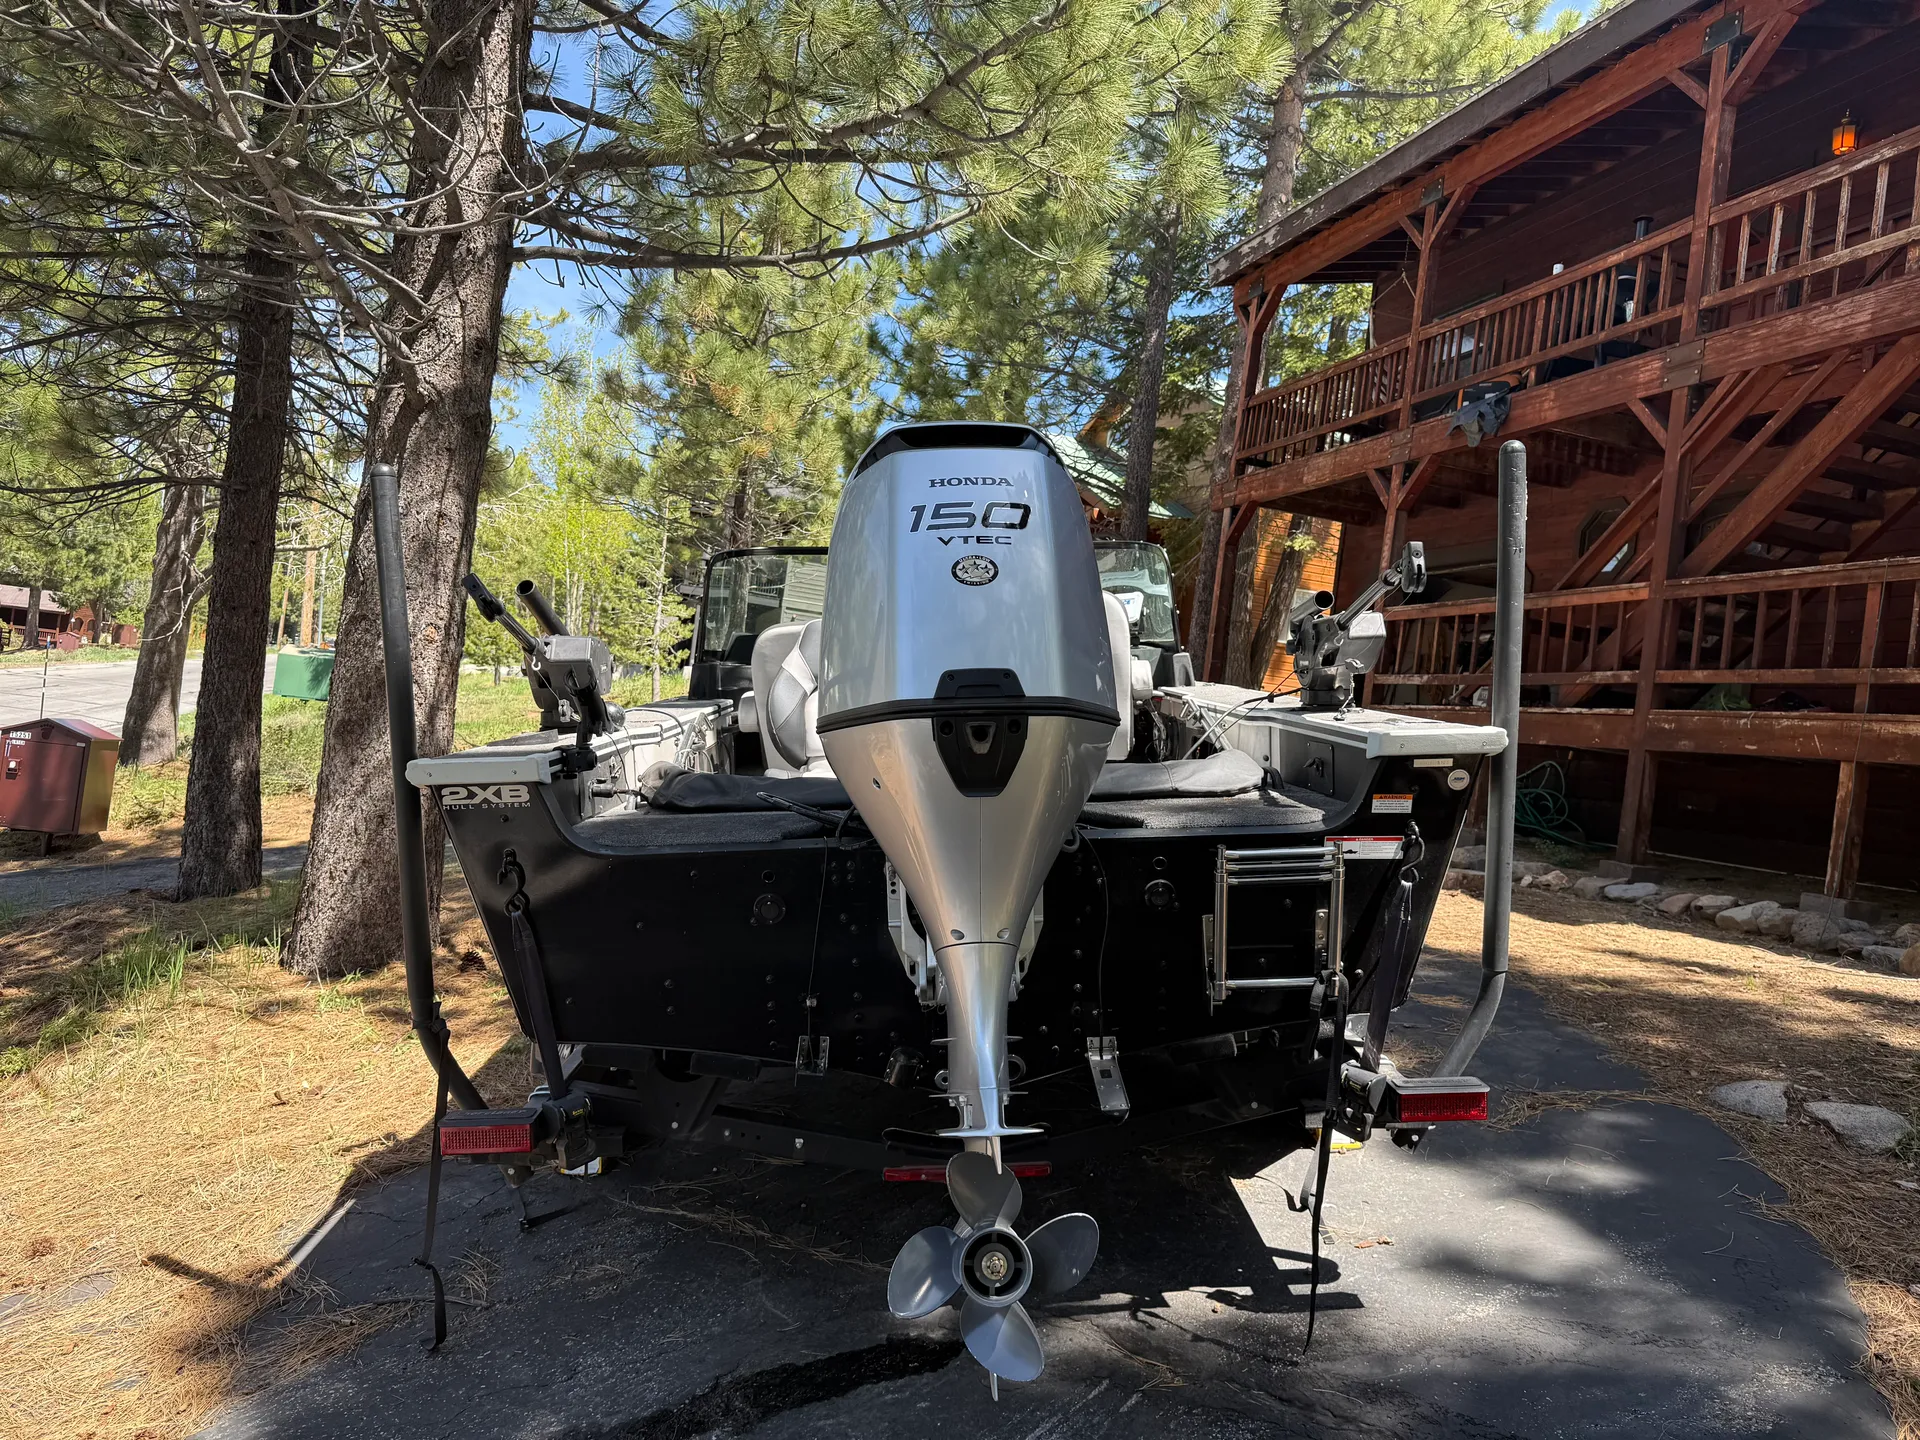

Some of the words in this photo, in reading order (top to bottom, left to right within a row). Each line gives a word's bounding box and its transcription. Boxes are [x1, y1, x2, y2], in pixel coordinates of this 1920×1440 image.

[929, 477, 1014, 488] HONDA
[909, 501, 1032, 534] 150
[937, 536, 1012, 546] VTEC
[441, 785, 530, 805] 2XB
